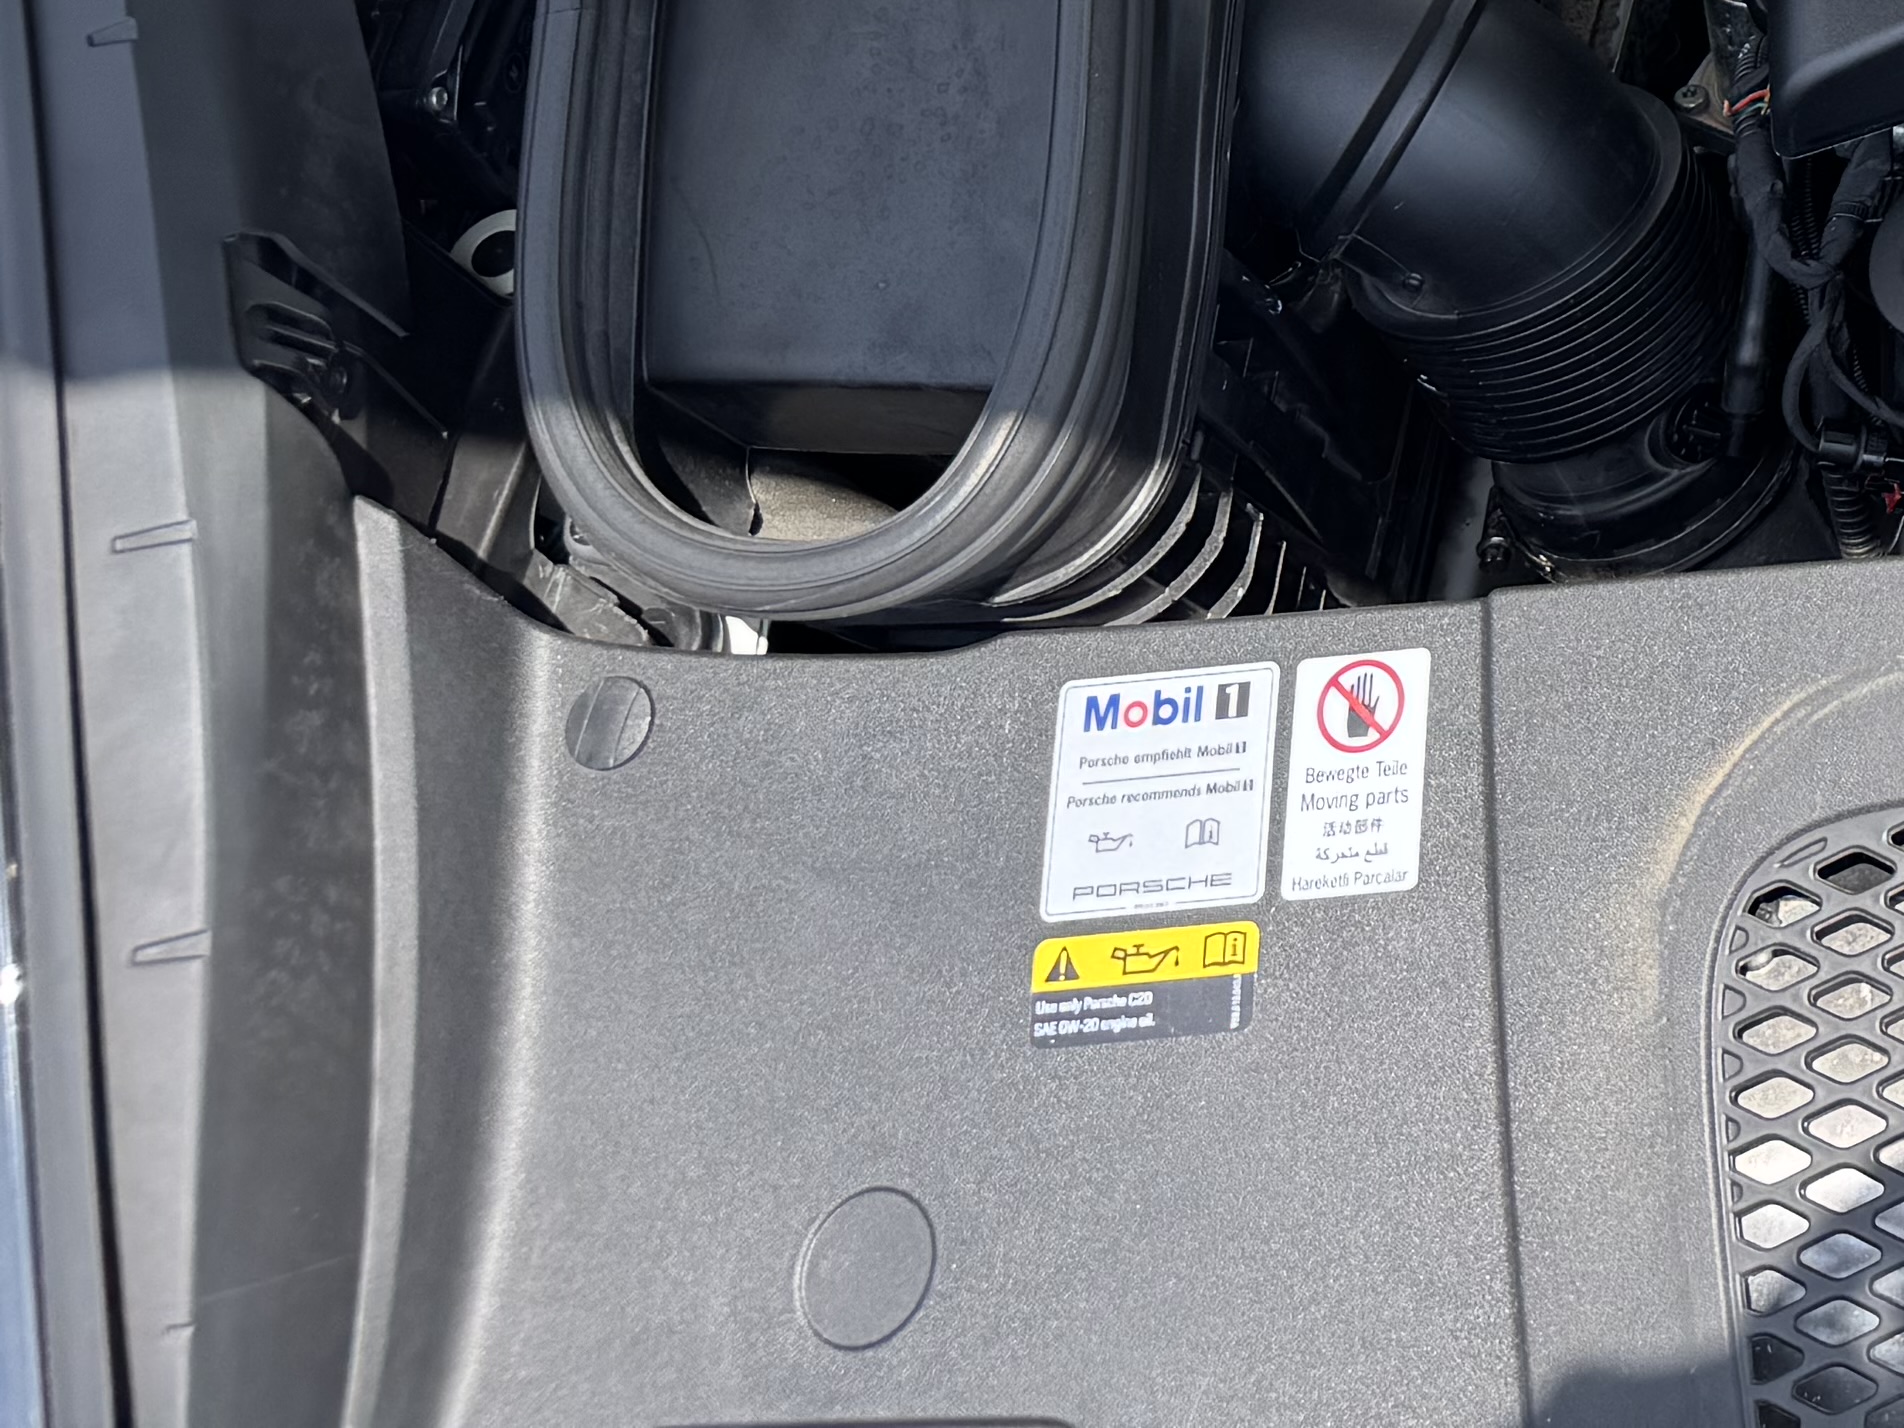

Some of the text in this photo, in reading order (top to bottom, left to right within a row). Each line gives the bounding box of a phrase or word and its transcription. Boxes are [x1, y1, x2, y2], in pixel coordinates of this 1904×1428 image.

[1084, 686, 1204, 732] Mobil
[1079, 755, 1129, 770] Porsche
[1134, 746, 1191, 765] empfiehlt
[1197, 742, 1233, 758] Mobil
[1305, 760, 1408, 784] Bewegte Teile
[1066, 795, 1117, 809] Porsche
[1121, 784, 1201, 804] recommends
[1206, 780, 1241, 796] Mobil
[1300, 785, 1409, 812] Moving parts
[1072, 872, 1233, 902] PORSCHE
[1034, 991, 1153, 1015] Use only Porsche C20
[1033, 1013, 1156, 1037] SAE 0W-20 engine oil.
